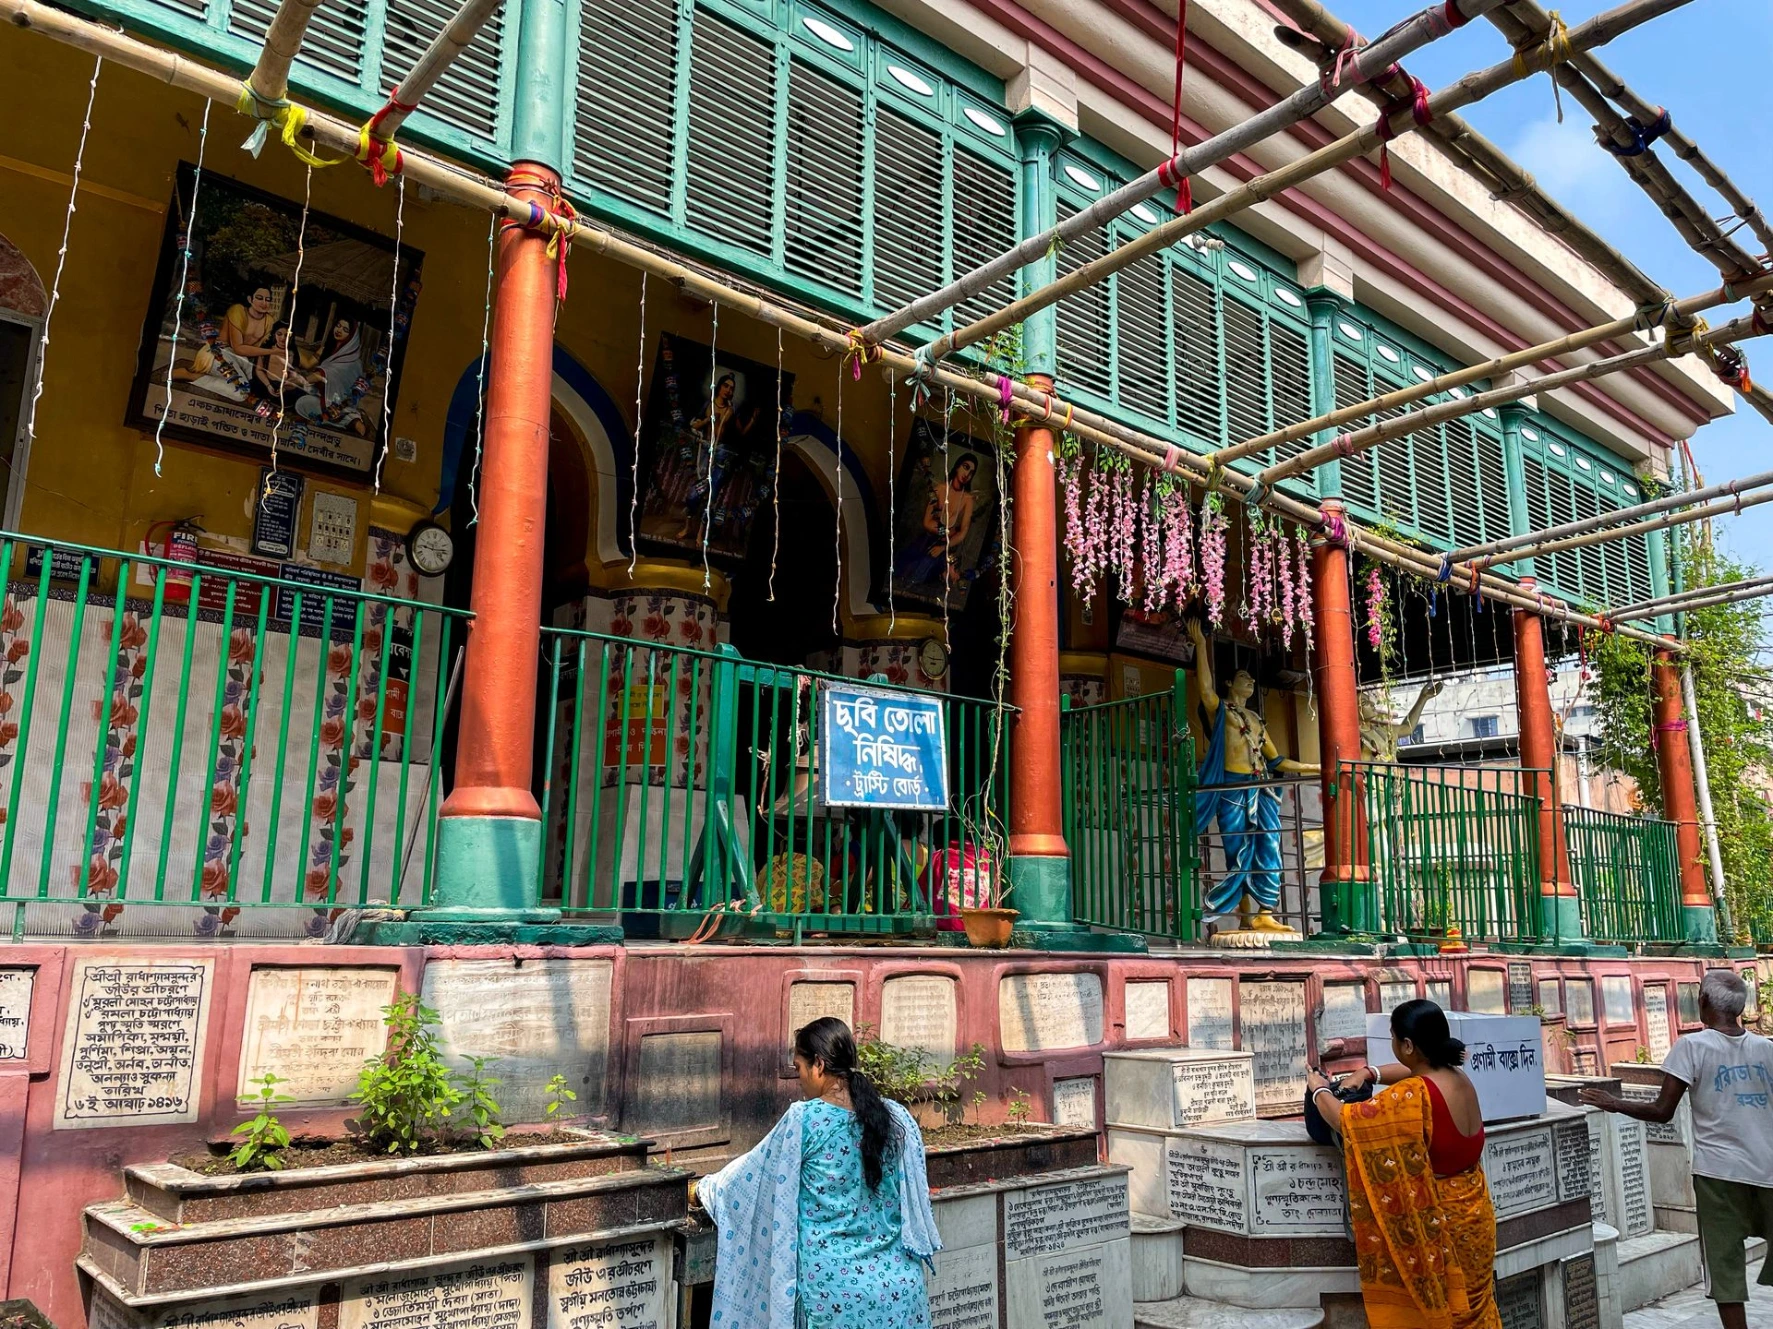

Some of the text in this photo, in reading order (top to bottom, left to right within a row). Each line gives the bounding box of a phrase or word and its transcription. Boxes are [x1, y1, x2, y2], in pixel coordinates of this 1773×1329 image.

[833, 698, 936, 737] ছবি তোলা
[894, 775, 923, 804] বোর্ড
[125, 997, 153, 1007] মোহন
[1470, 1044, 1496, 1072] প্রণামী
[101, 1084, 146, 1096] তারিখ
[148, 1096, 182, 1108] ১৪১৬
[565, 1265, 594, 1287] জীউ
